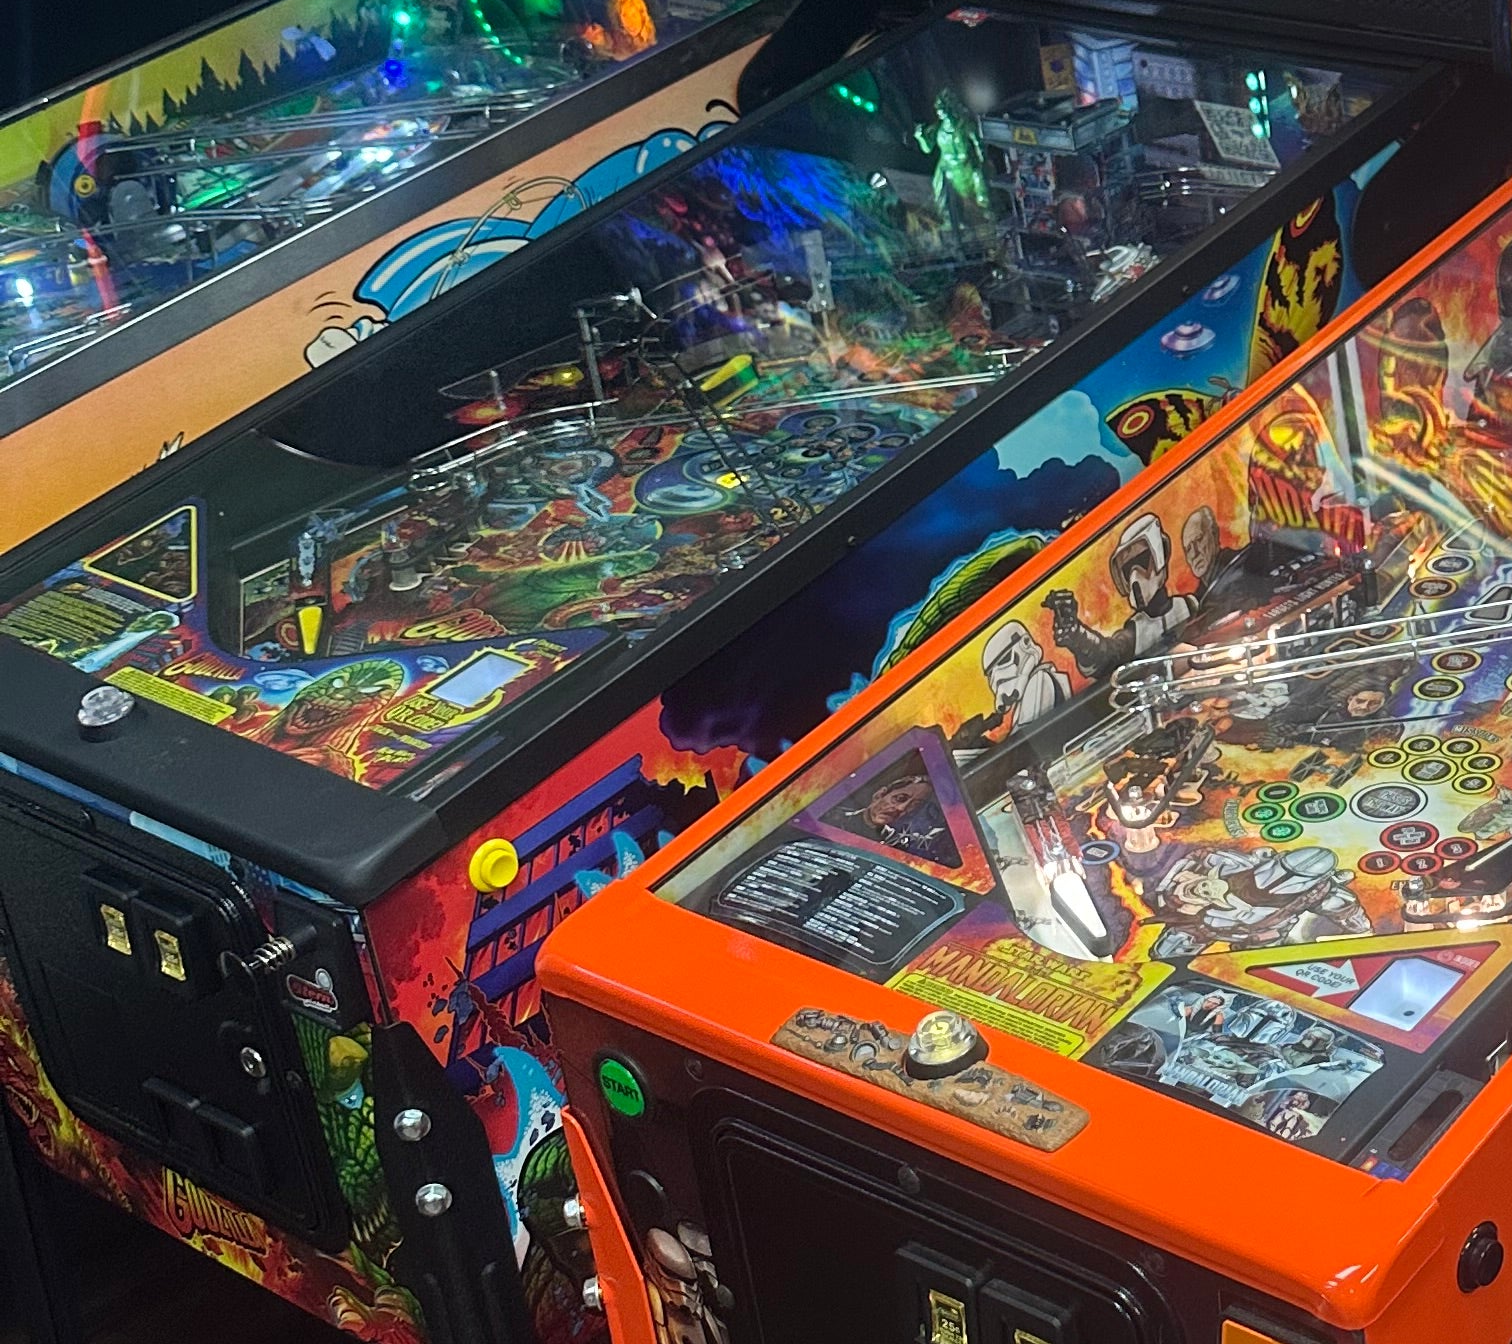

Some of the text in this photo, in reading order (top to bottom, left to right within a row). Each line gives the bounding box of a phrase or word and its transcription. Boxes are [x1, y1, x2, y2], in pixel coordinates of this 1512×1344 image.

[999, 944, 1092, 980] STAR WARS
[1306, 962, 1355, 985] USE YOUR
[917, 945, 1118, 1035] MANDALORIAN
[1295, 968, 1342, 989] QR CODE!
[601, 1073, 641, 1102] START
[163, 1164, 270, 1256] GODZILLA
